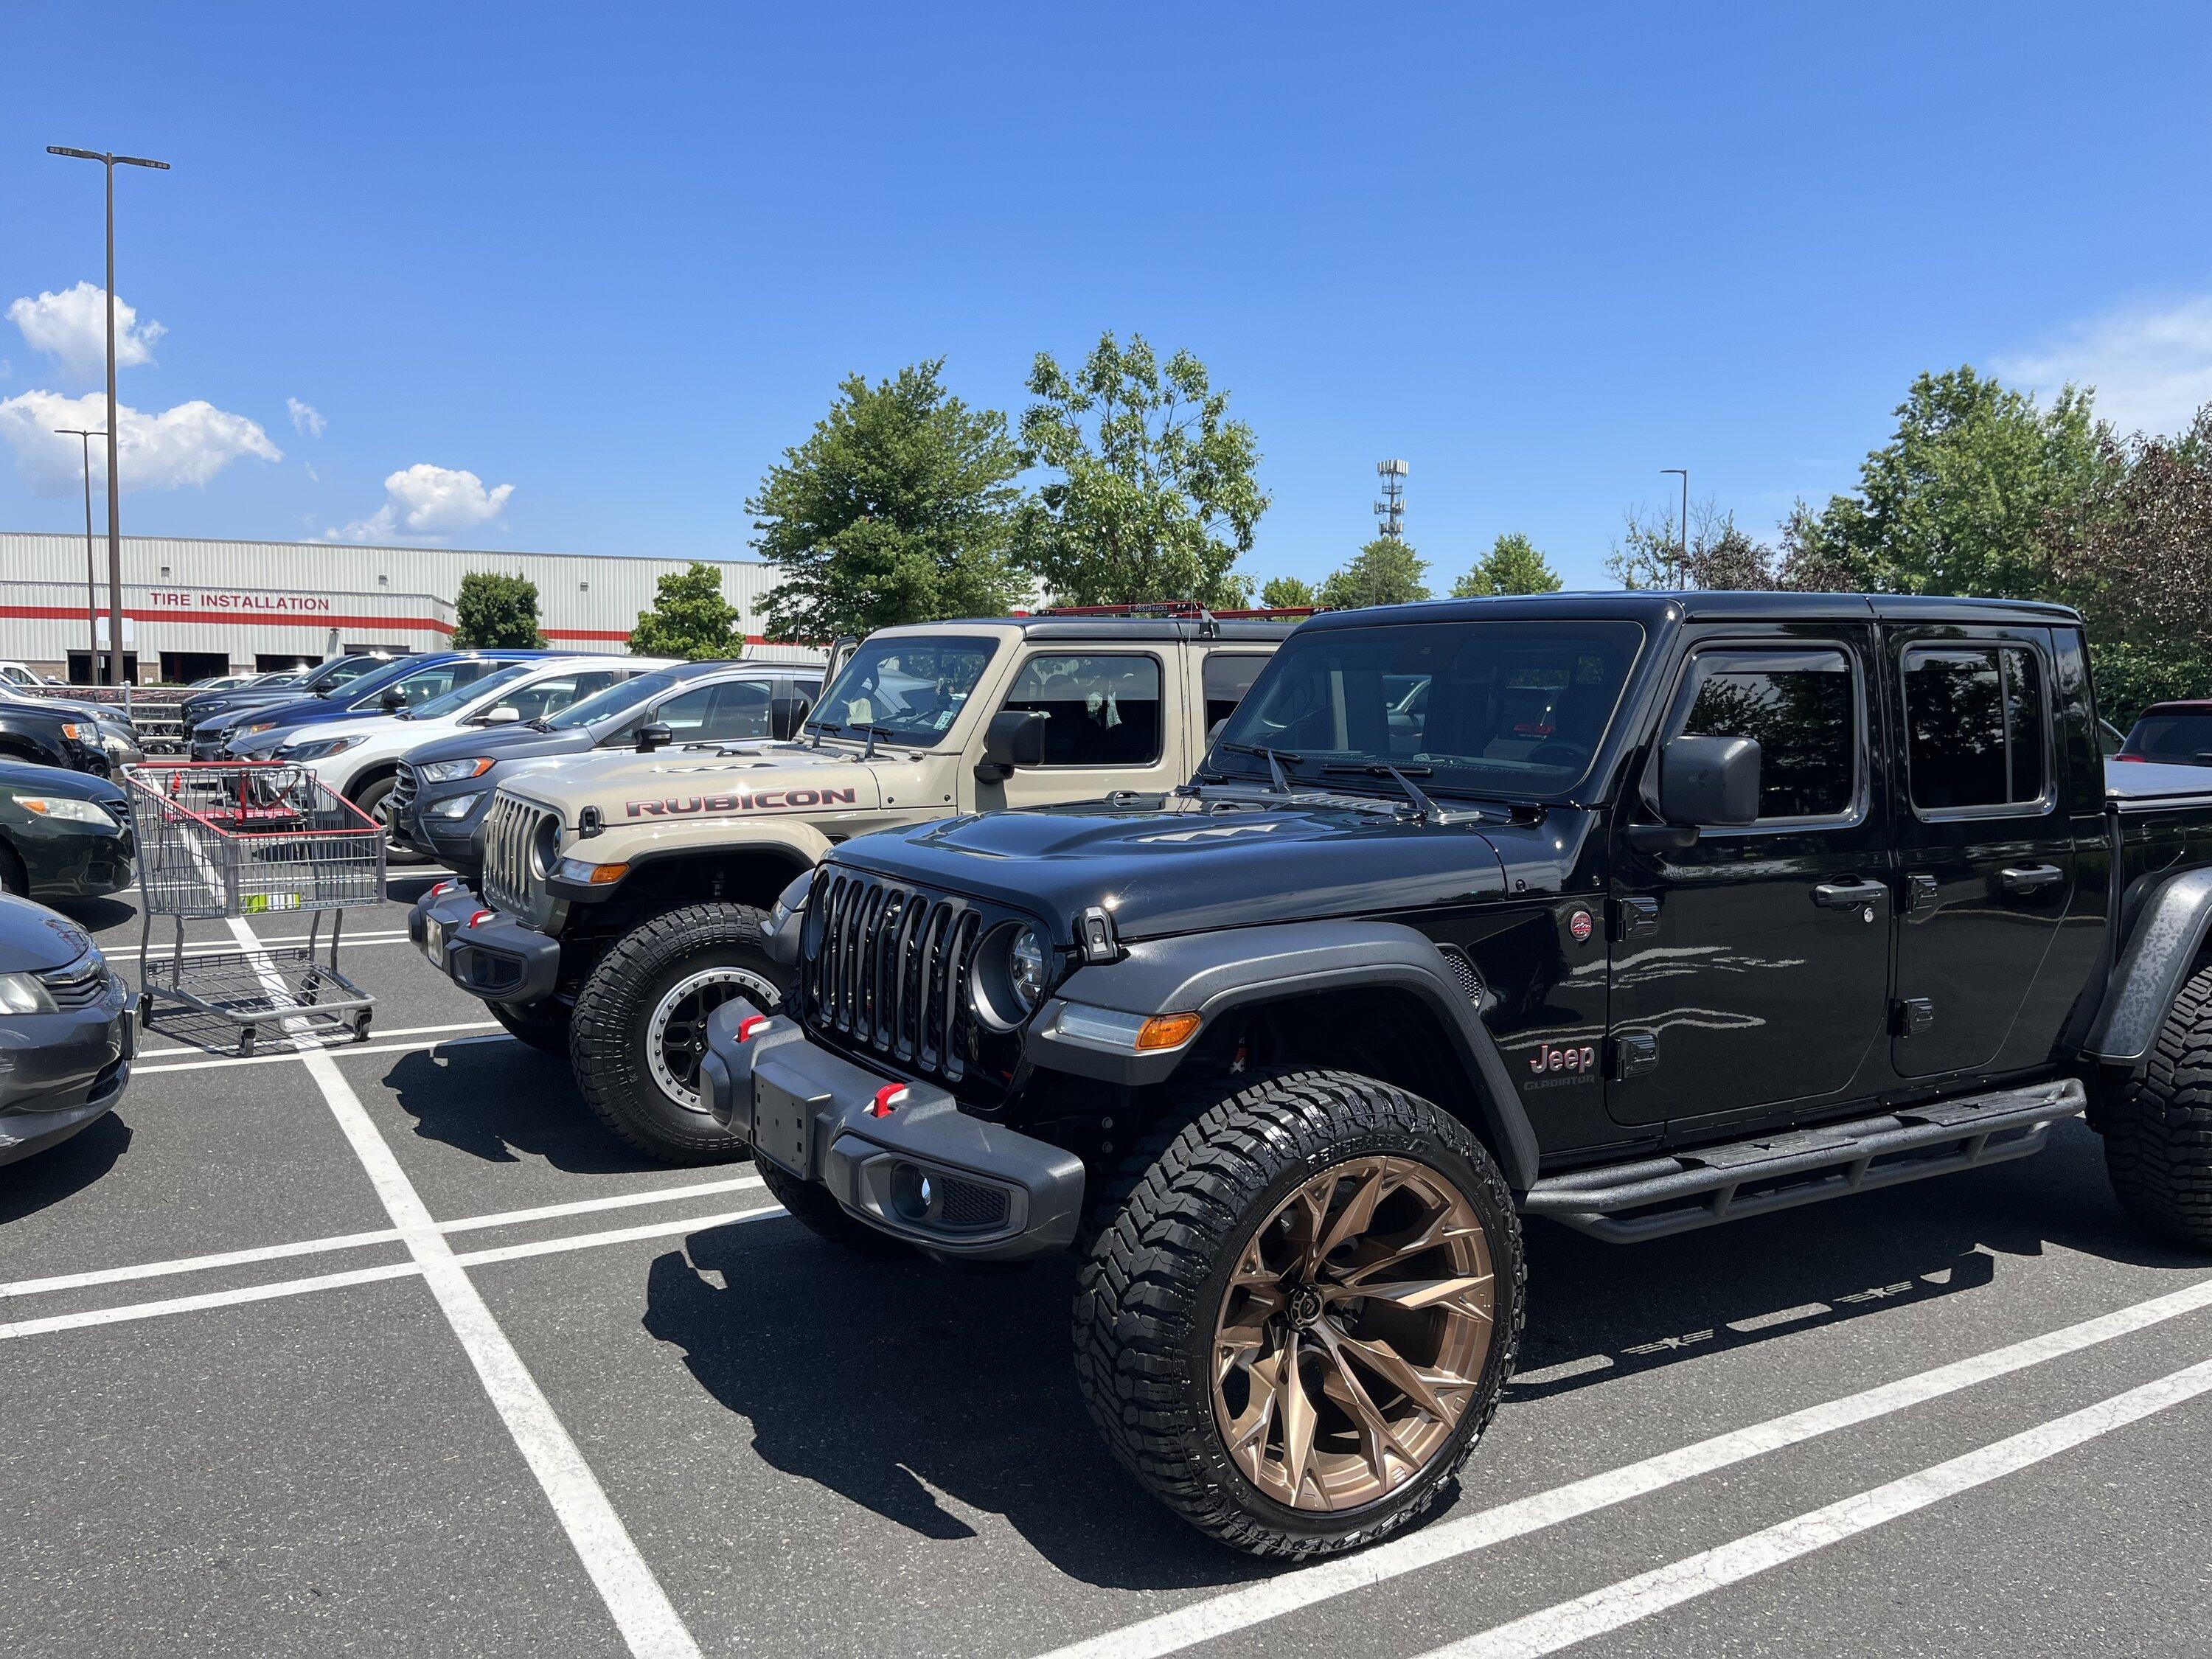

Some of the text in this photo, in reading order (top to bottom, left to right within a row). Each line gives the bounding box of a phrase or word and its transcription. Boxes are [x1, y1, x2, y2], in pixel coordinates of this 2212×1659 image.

[150, 592, 330, 611] TIRE INSTALLATION
[625, 787, 856, 818] RUBICON
[1529, 1045, 1595, 1074] Jeep
[1523, 1074, 1595, 1091] GLADIATOR
